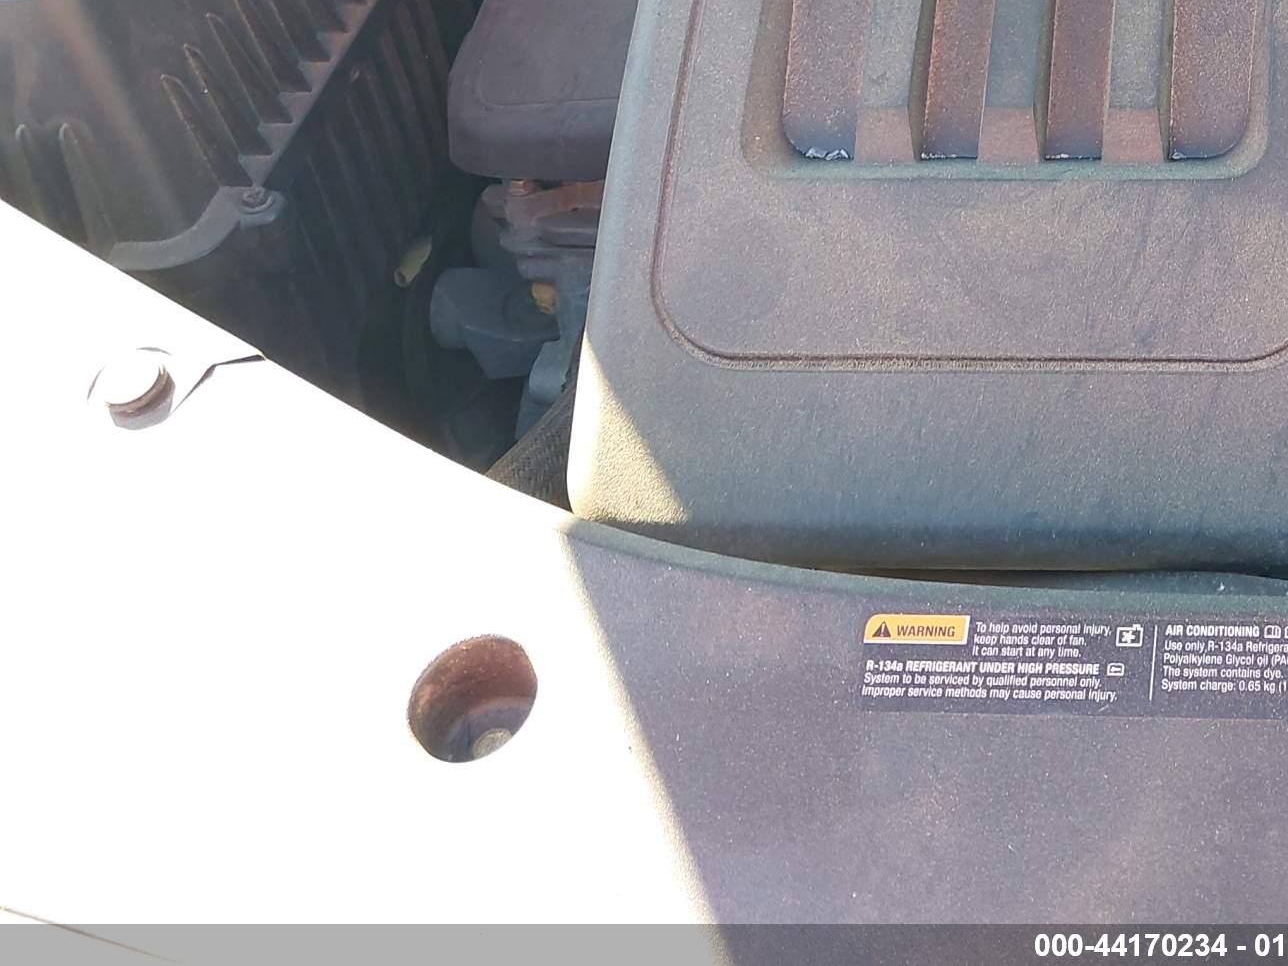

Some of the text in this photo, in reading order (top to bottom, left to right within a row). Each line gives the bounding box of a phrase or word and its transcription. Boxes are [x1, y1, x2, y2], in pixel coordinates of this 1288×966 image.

[896, 625, 955, 638] WARNING
[976, 623, 986, 633] To
[989, 623, 1009, 636] help
[1012, 623, 1037, 634] avoid
[1040, 624, 1081, 636] personal
[1166, 625, 1259, 637] AIR CONDITIONING
[974, 635, 997, 647] keep
[999, 636, 1028, 645] hands
[1031, 636, 1055, 646] clear
[1057, 636, 1067, 646] of
[1164, 641, 1183, 651] Use
[1207, 642, 1243, 652] R-134a
[972, 646, 978, 656] It
[981, 648, 998, 657] can
[1000, 647, 1023, 657] start
[1025, 648, 1036, 657] at
[1038, 649, 1055, 659] any
[1164, 654, 1223, 666] Polyalkylene
[1226, 654, 1254, 666] Glycol
[1257, 655, 1269, 667] oil
[866, 660, 1099, 675] R-134a REFRIGERANT UNDER HIGH PRESSURE
[1163, 666, 1283, 679] The system contains dye.
[864, 672, 1102, 689] System to be serviced by qualified personnel only.
[1162, 679, 1197, 691] System
[1200, 681, 1236, 693] charge:
[1239, 681, 1260, 691] 0.65
[1264, 681, 1276, 693] kg
[862, 685, 905, 698] Improper
[907, 687, 942, 697] service
[945, 687, 987, 698] methods
[990, 689, 1010, 700] may
[1013, 689, 1041, 699] cause
[1044, 688, 1085, 701] personal
